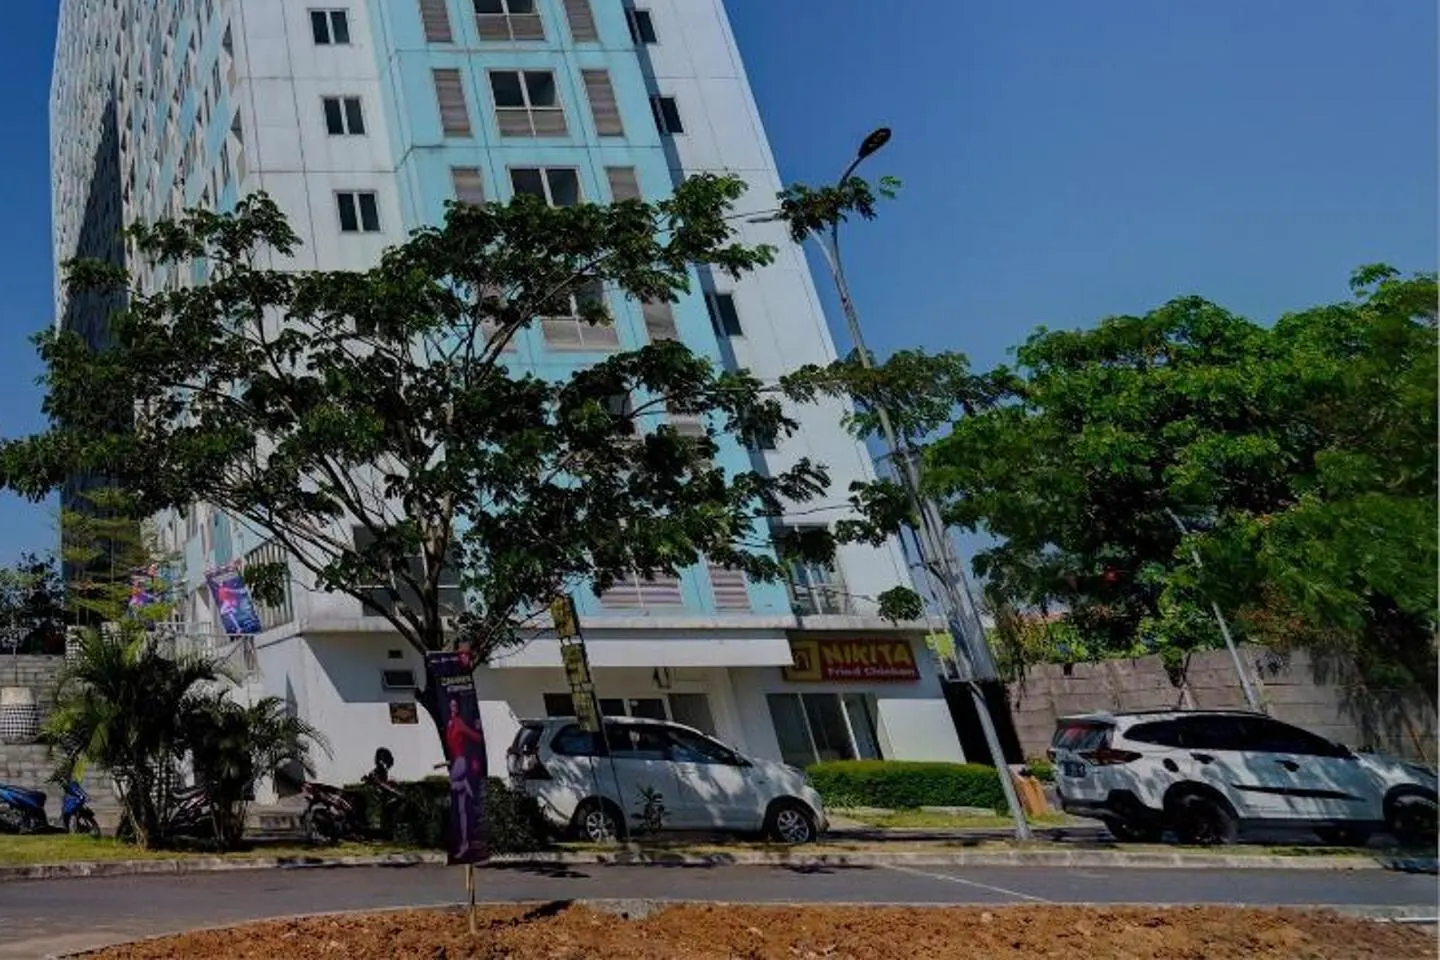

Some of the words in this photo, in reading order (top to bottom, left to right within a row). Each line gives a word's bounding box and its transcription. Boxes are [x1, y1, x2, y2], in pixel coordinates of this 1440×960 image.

[821, 642, 912, 666] NIKITA
[827, 666, 861, 677] Fried
[863, 666, 916, 678] Chicken
